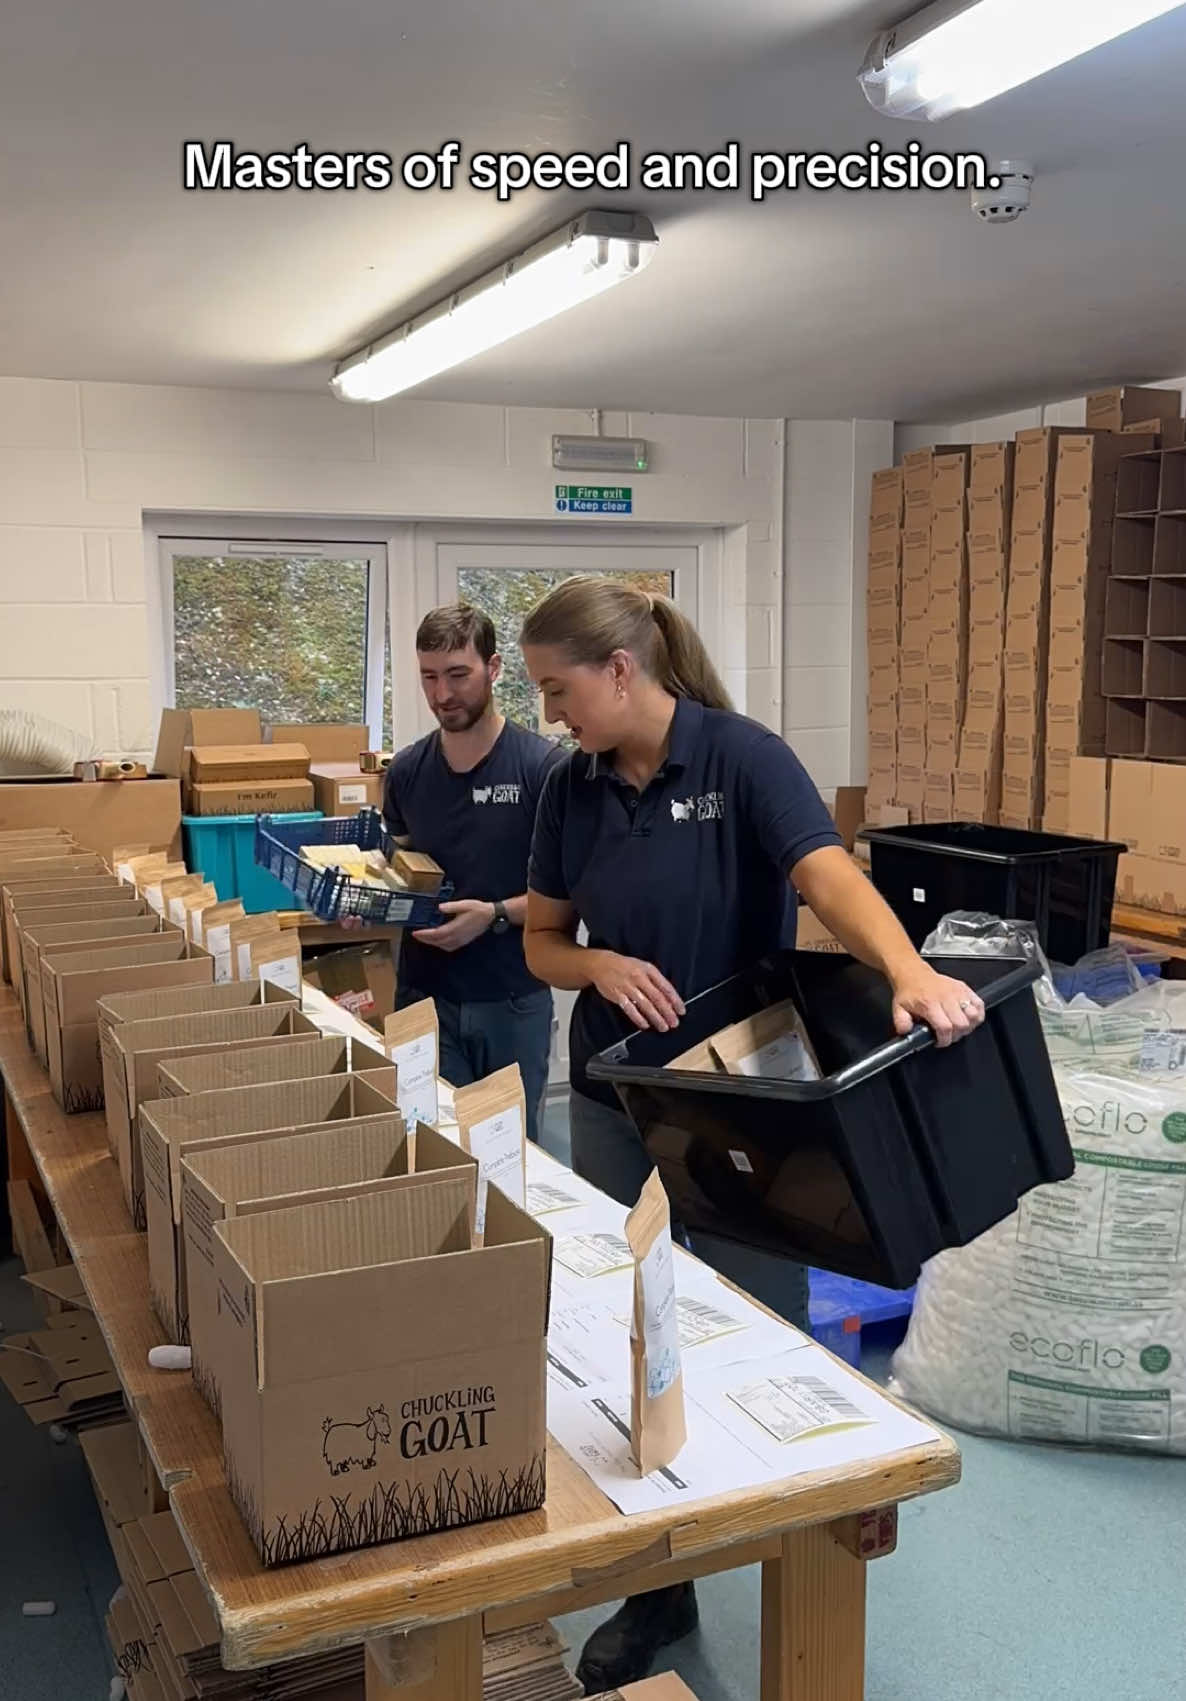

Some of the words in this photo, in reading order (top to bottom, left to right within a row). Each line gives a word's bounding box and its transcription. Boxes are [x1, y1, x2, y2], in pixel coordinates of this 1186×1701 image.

[577, 487, 599, 498] Fire
[603, 488, 623, 498] exit
[574, 500, 599, 511] Keep
[602, 501, 627, 511] clear
[255, 791, 278, 800] Kefir
[492, 790, 520, 804] GOAT
[1009, 1331, 1126, 1369] ecoflo
[401, 1385, 497, 1419] CHUCKLING
[400, 1406, 497, 1460] GOAT
